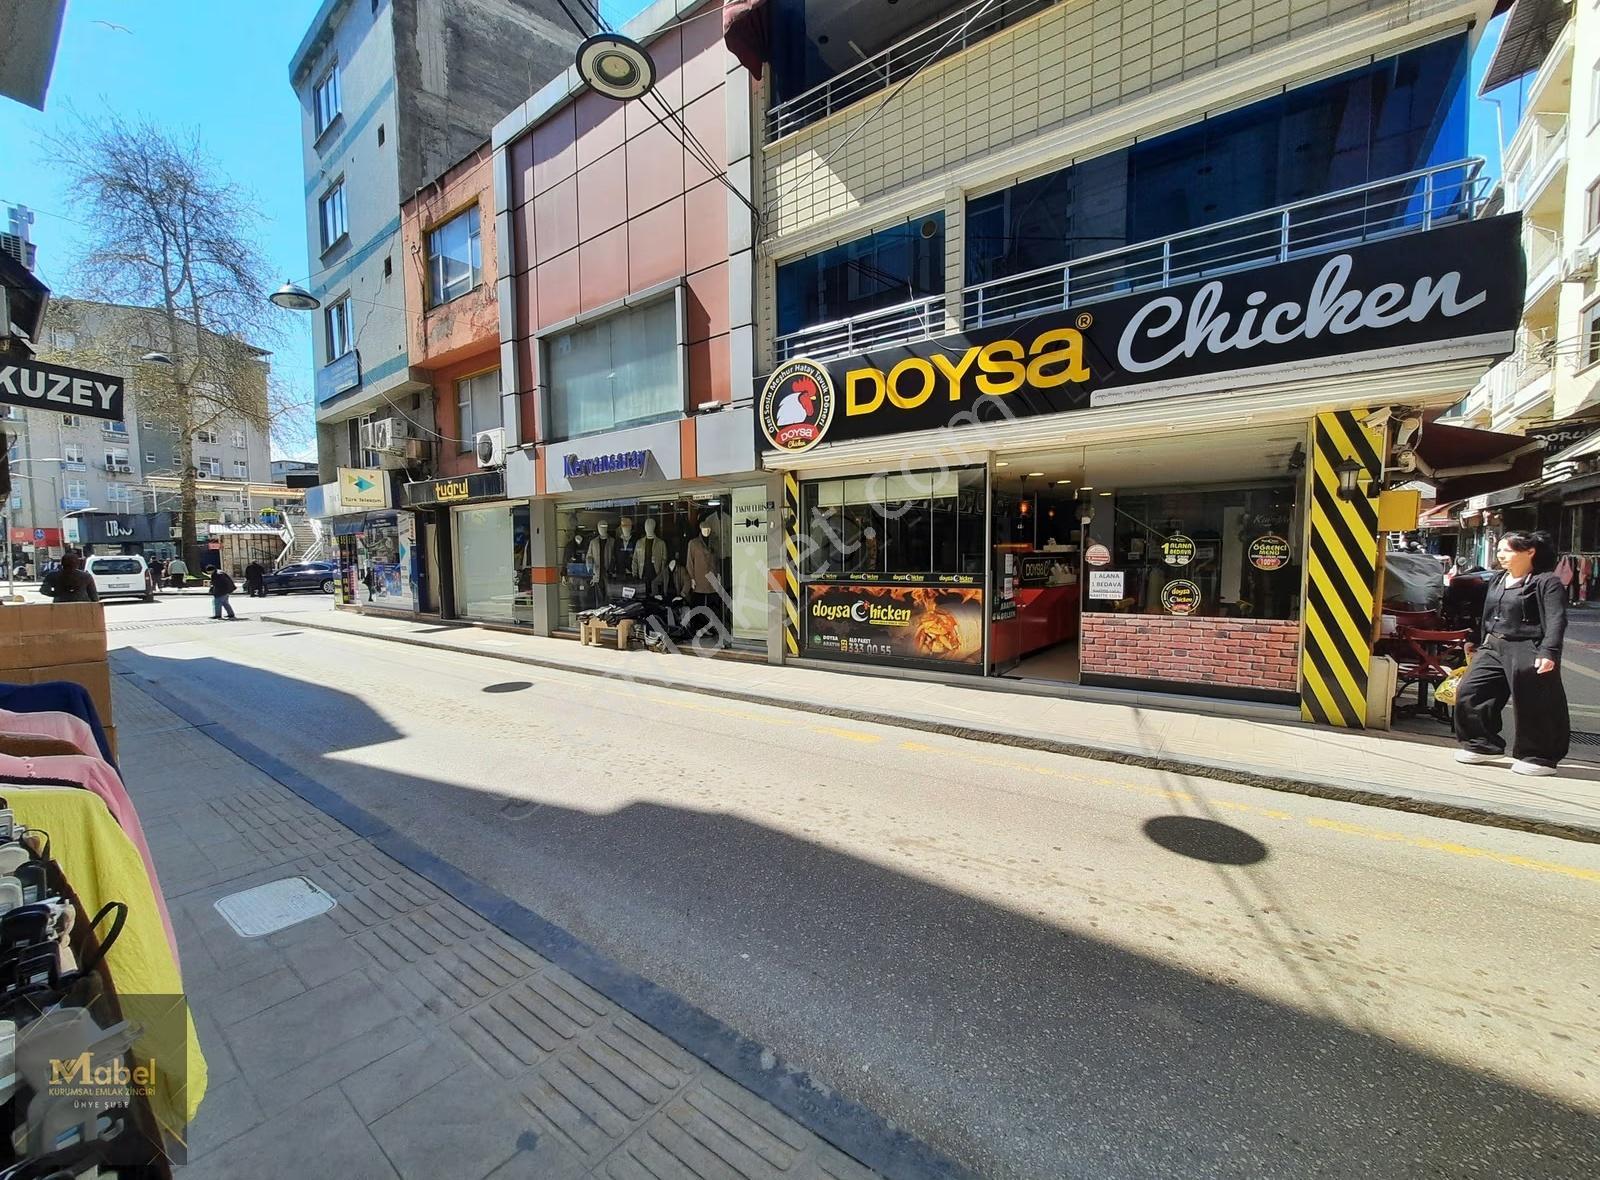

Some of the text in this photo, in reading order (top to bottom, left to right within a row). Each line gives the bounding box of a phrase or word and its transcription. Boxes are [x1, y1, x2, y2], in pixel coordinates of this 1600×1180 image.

[1116, 254, 1486, 374] Chicken
[0, 365, 118, 410] KUZEY
[763, 392, 774, 415] Soslu
[794, 364, 815, 374] Hatay
[814, 371, 829, 393] Tavuk
[562, 449, 649, 480] Kervansaray
[435, 477, 469, 499] tuğrul
[105, 520, 119, 537] LTB
[1161, 542, 1170, 555] 1
[812, 600, 850, 621] doysa
[848, 642, 892, 656] 333 00 55
